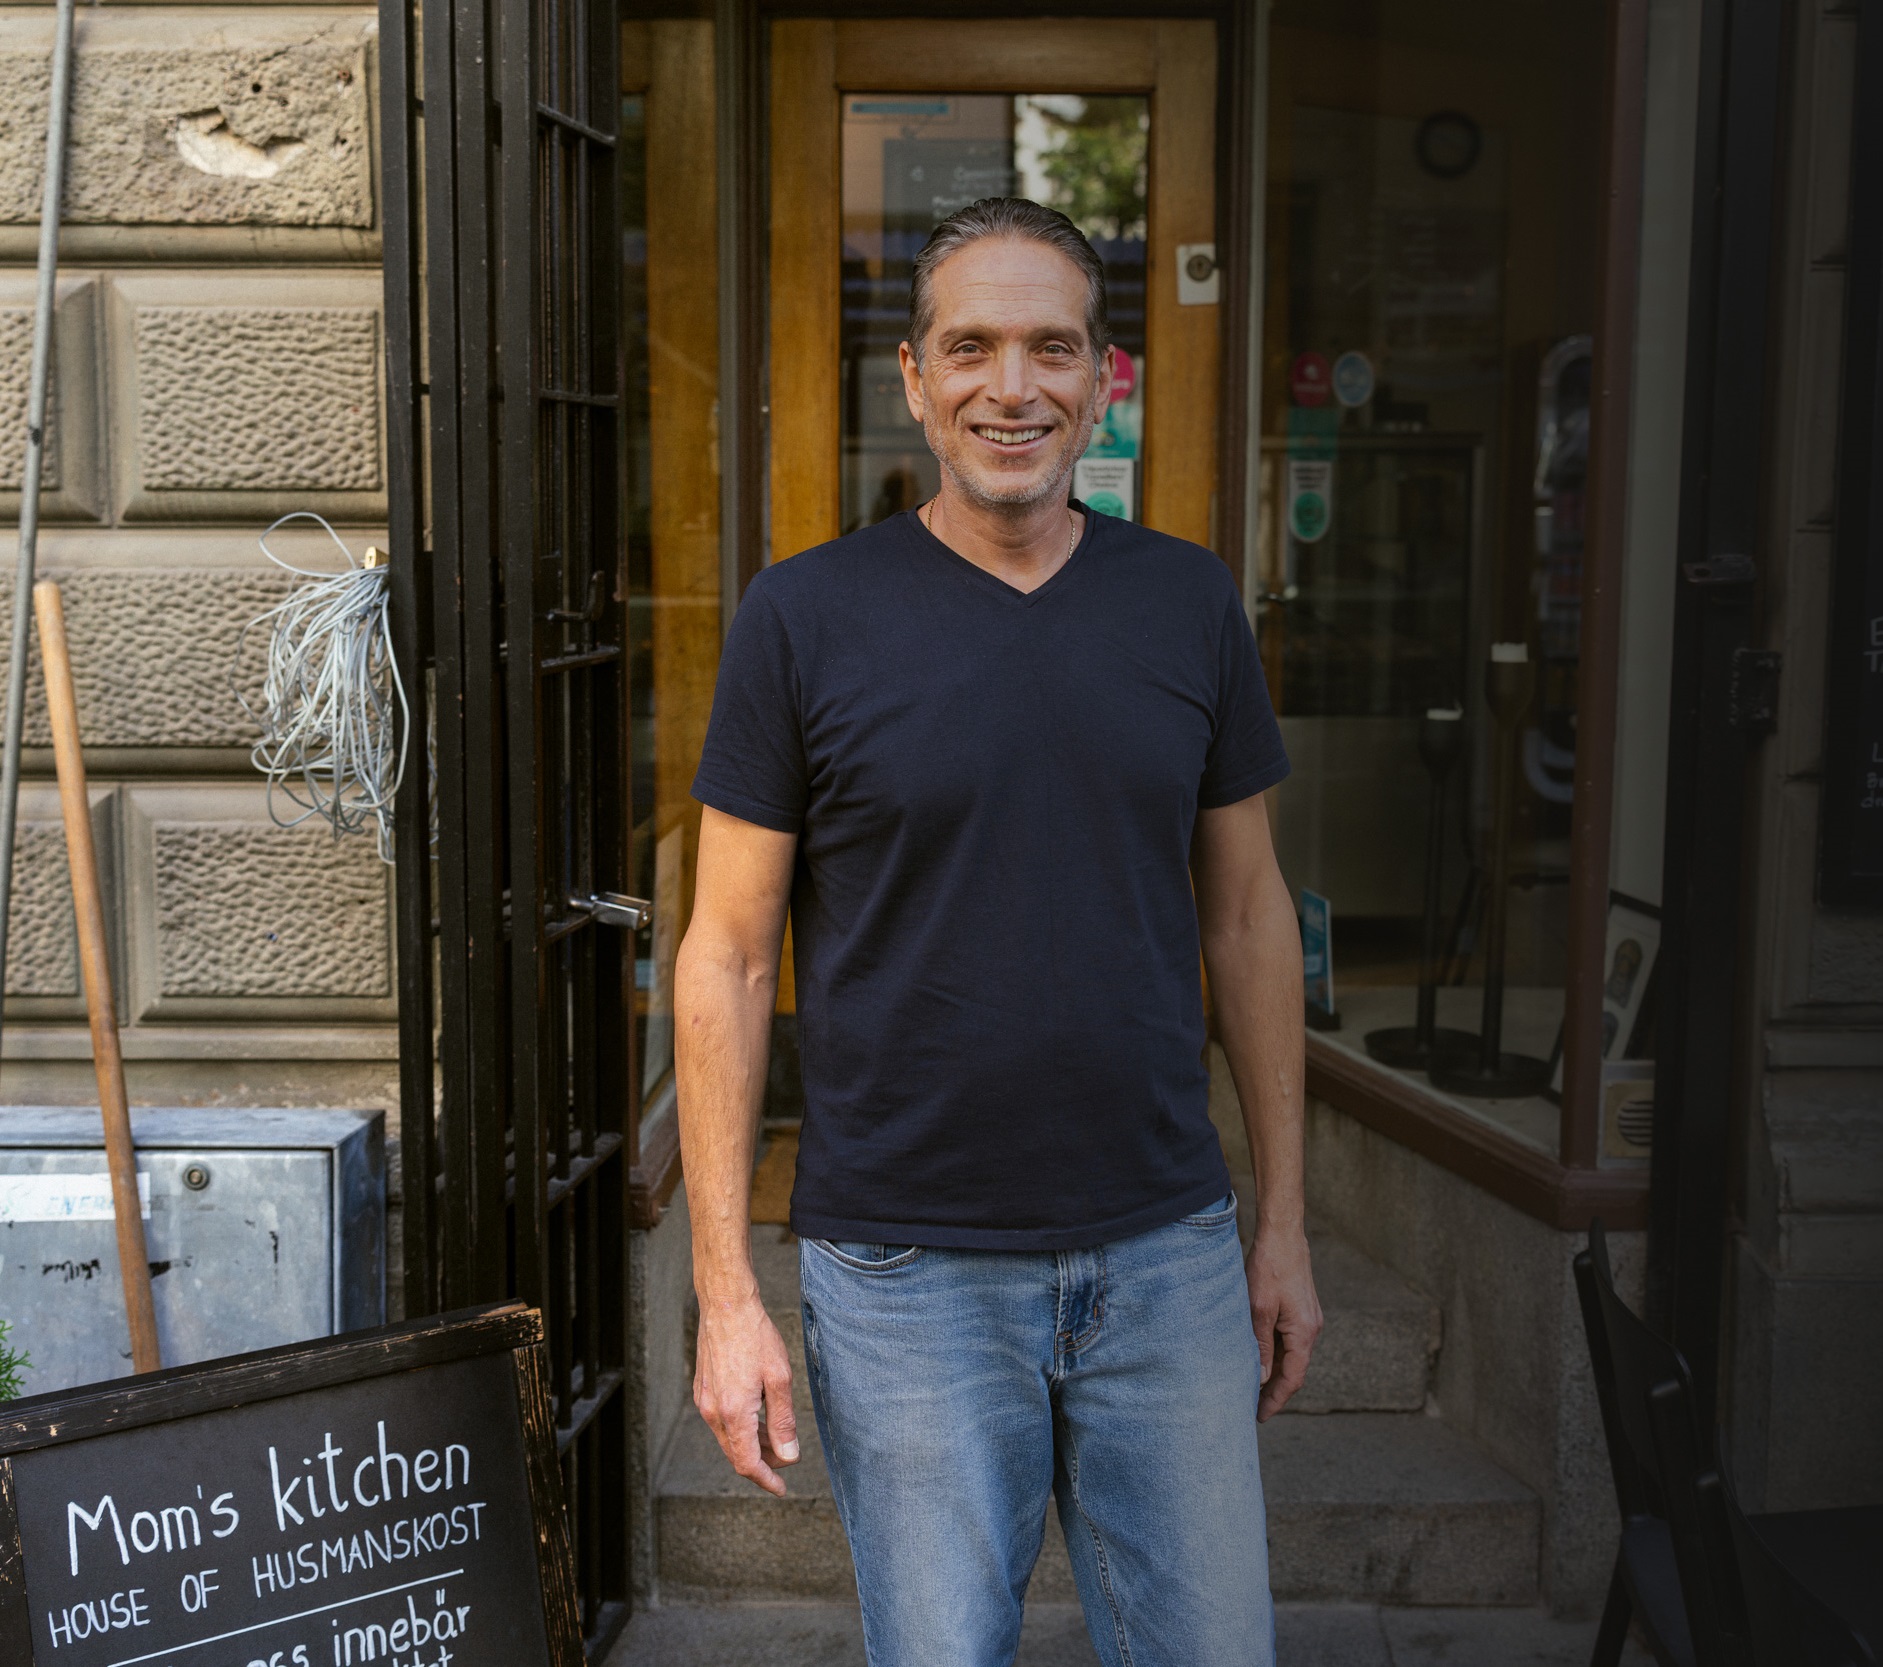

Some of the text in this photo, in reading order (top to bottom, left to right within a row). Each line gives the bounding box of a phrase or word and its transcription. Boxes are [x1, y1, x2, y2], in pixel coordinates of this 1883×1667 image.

[67, 1420, 470, 1576] Mom's kitchen
[48, 1502, 487, 1648] HOUSE OF HUSMANSKOST
[331, 1589, 471, 1667] innebär
